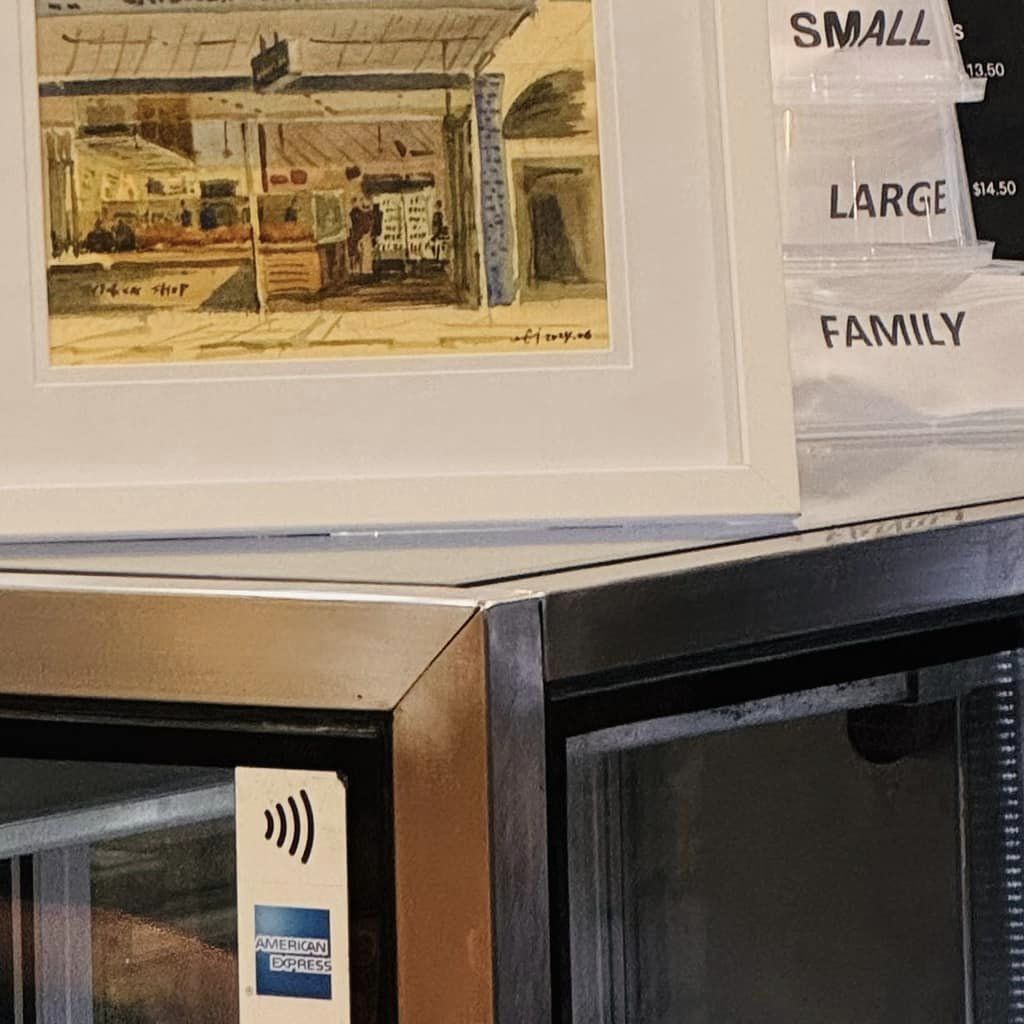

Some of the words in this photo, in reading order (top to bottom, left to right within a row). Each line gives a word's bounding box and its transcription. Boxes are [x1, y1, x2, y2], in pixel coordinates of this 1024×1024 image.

[789, 9, 930, 49] SMALL
[829, 179, 946, 219] LARGE
[972, 180, 1017, 197] $14.50
[820, 311, 965, 349] FAMILY
[256, 937, 326, 953] AMERICAN
[272, 956, 332, 972] EXPRESS
